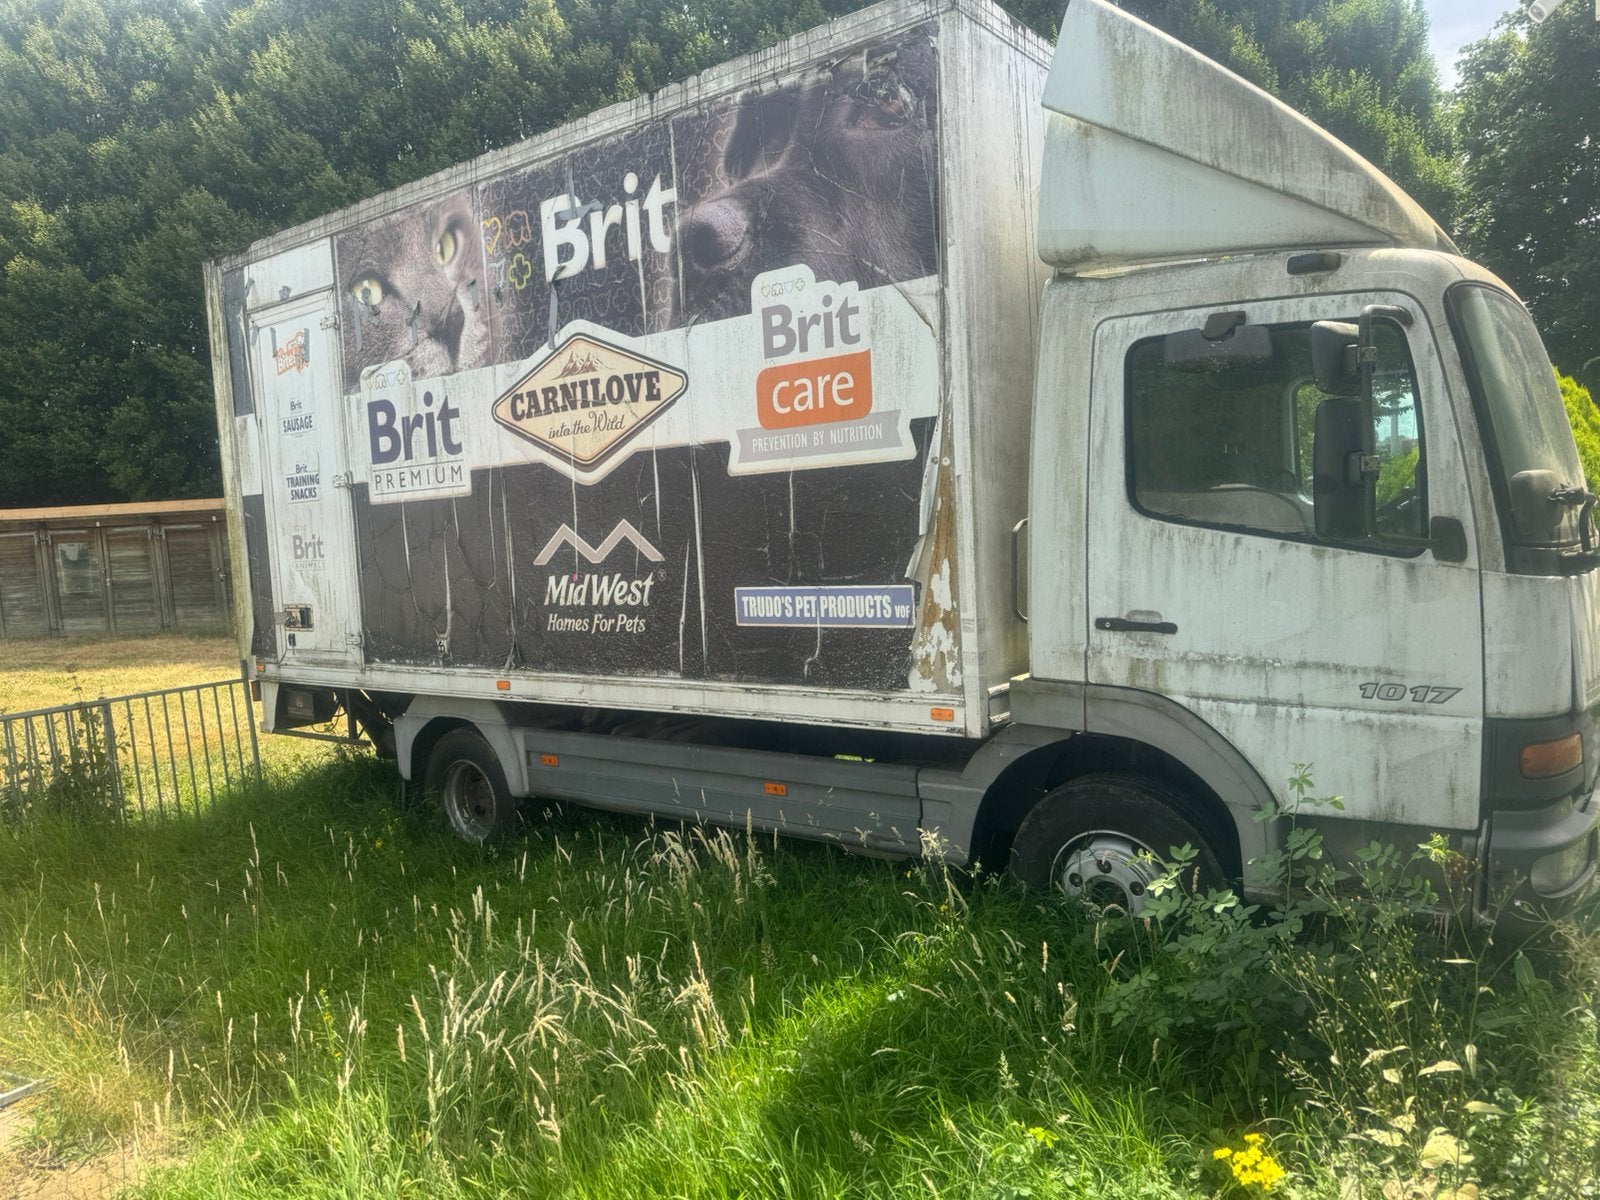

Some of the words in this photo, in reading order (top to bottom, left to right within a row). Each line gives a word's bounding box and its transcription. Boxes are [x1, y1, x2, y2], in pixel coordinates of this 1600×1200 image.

[540, 172, 677, 283] Brit
[761, 294, 861, 360] Brit
[290, 400, 303, 411] Brit
[510, 370, 661, 422] CARNILOVE
[772, 371, 854, 415] care
[283, 415, 313, 433] SAUSAGE
[367, 391, 463, 465] Brit
[548, 427, 572, 439] into
[572, 419, 591, 435] the
[589, 410, 626, 432] Wild
[752, 432, 808, 453] PREVENTION
[813, 430, 825, 446] BY
[830, 423, 883, 444] NUTRITION
[286, 474, 320, 488] TRAINING
[295, 464, 308, 474] Brit
[374, 465, 463, 491] PREMIUM
[290, 487, 317, 500] SNACKS
[292, 534, 325, 560] Brit
[544, 572, 654, 606] MidWest
[742, 595, 793, 618] TRUDO'S
[795, 595, 817, 618] PET
[820, 594, 892, 619] PRODUCTS
[894, 605, 911, 618] VOF
[547, 613, 590, 632] Homes
[591, 613, 615, 634] For
[616, 613, 646, 634] Pets
[1359, 682, 1464, 704] 1017
